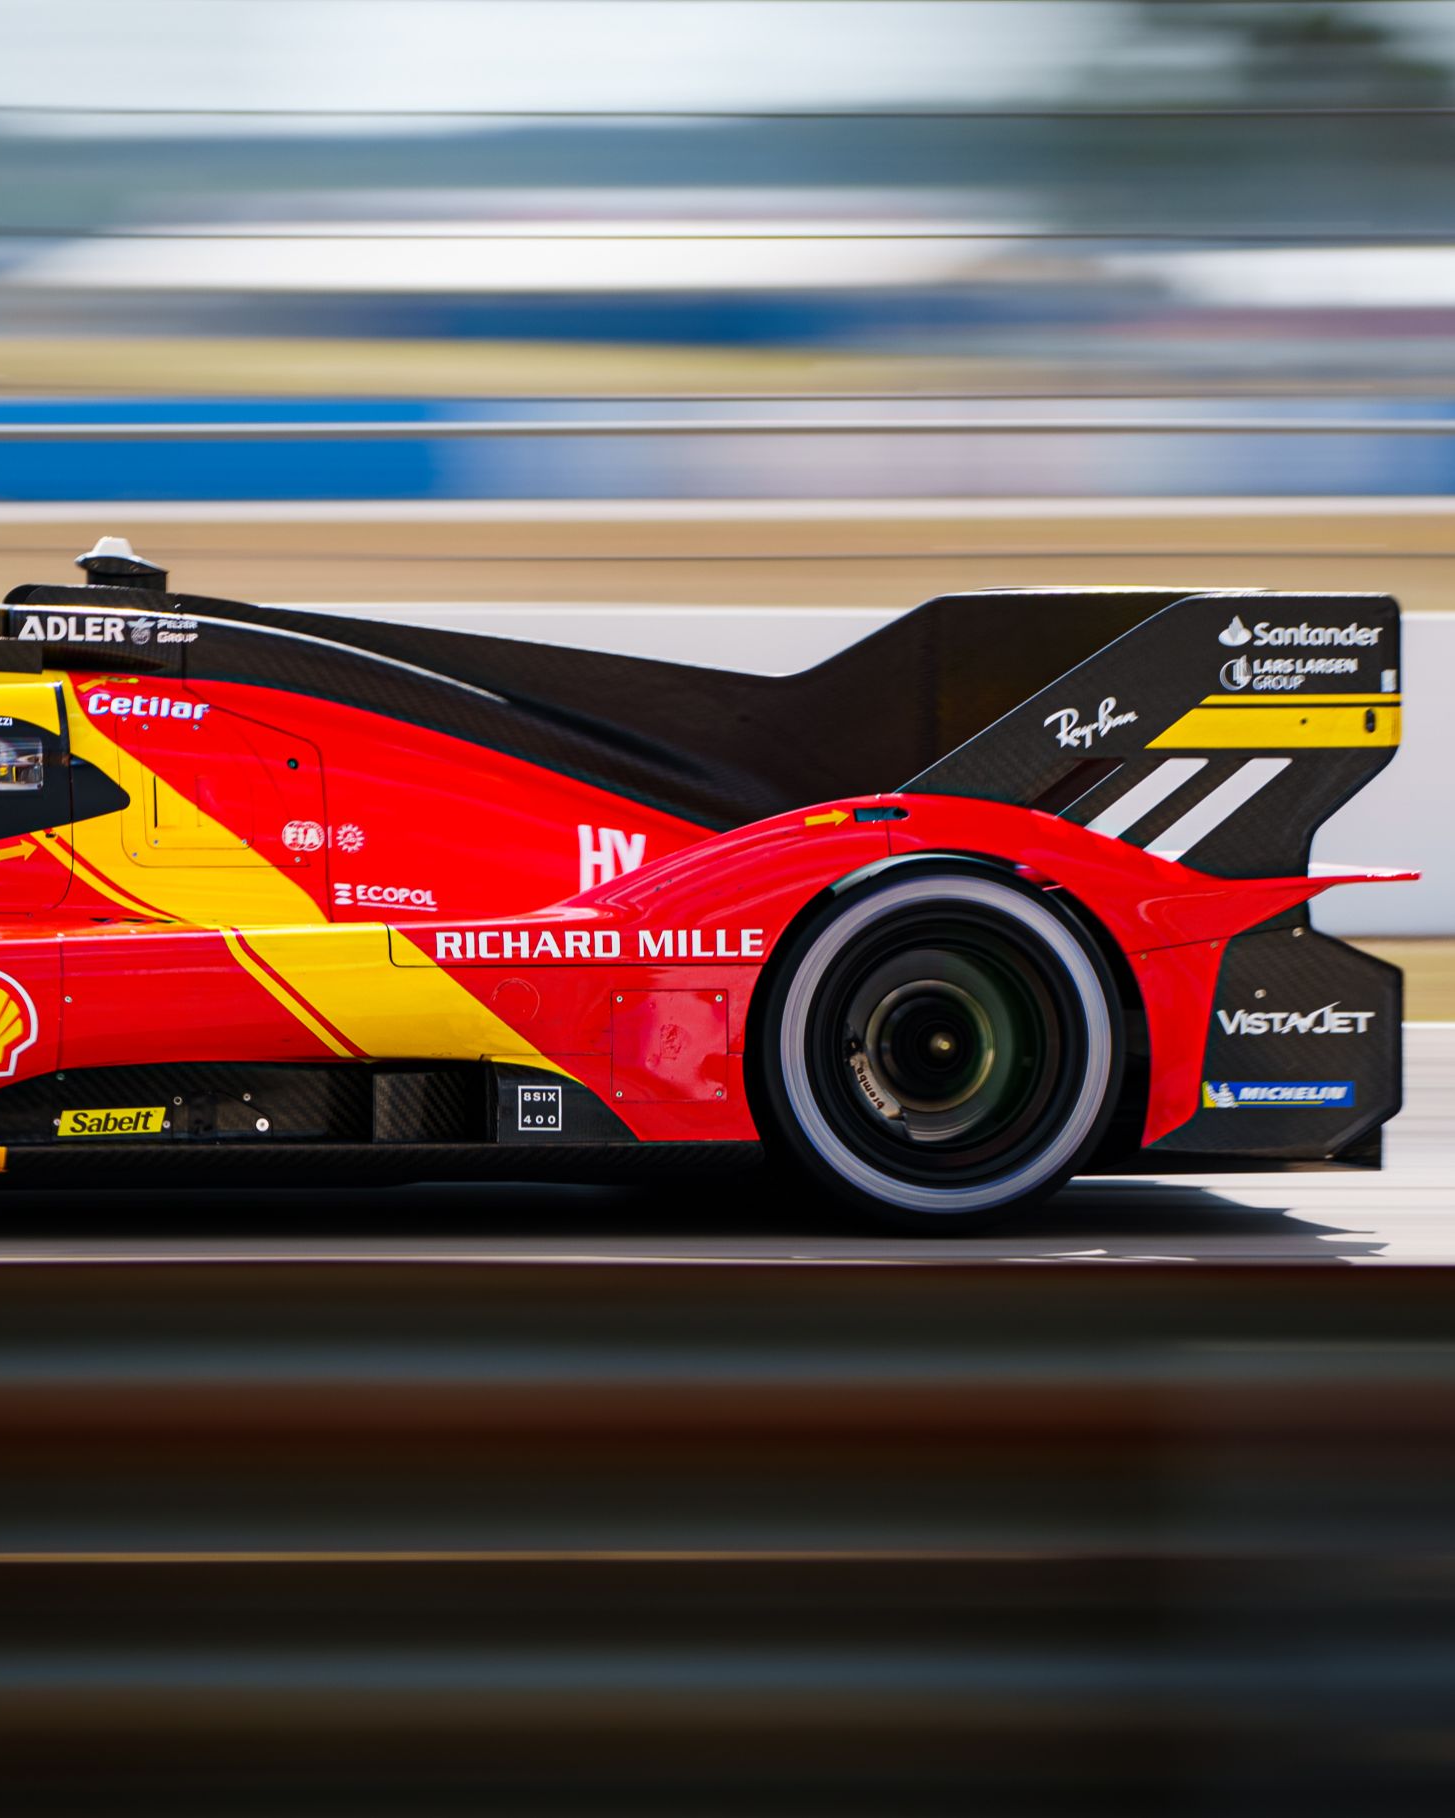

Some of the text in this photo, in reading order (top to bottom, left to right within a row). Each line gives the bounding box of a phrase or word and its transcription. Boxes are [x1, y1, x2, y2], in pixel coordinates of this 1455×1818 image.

[18, 615, 125, 643] ADLER
[157, 631, 198, 644] GROUP
[1253, 622, 1384, 647] Santander
[1252, 658, 1358, 675] LARS LARSEN
[1252, 675, 1305, 691] GROUP
[87, 693, 210, 720] Cetilar
[1043, 697, 1138, 748] Ray-Ban
[284, 826, 322, 847] FIA
[356, 884, 438, 906] ECOPOL
[435, 929, 764, 959] RICHARD MILLE
[1217, 1001, 1376, 1035] VISTAJET
[523, 1092, 556, 1102] 8SIX
[856, 1066, 885, 1111] brembo
[1238, 1086, 1348, 1101] MICHELIN
[70, 1110, 153, 1134] Sabelt
[523, 1114, 556, 1125] 400
